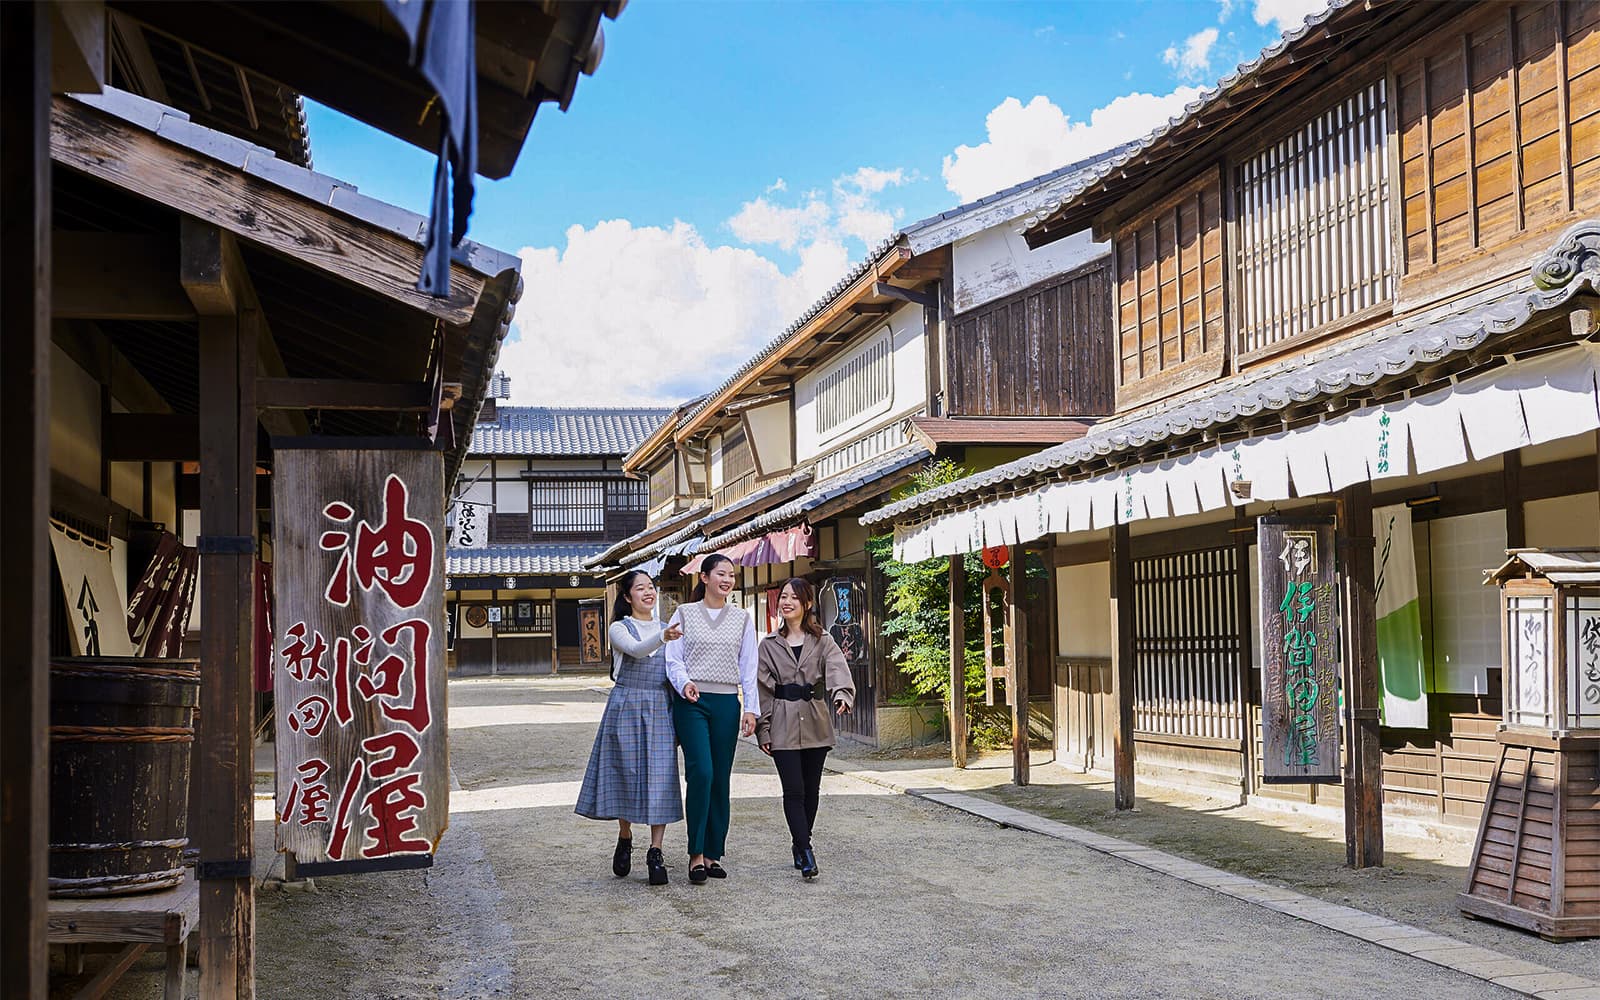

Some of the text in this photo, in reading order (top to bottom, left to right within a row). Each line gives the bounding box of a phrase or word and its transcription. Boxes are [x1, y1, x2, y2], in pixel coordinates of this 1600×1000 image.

[281, 621, 331, 827] 秋田屋
[319, 473, 433, 861] 油問屋
